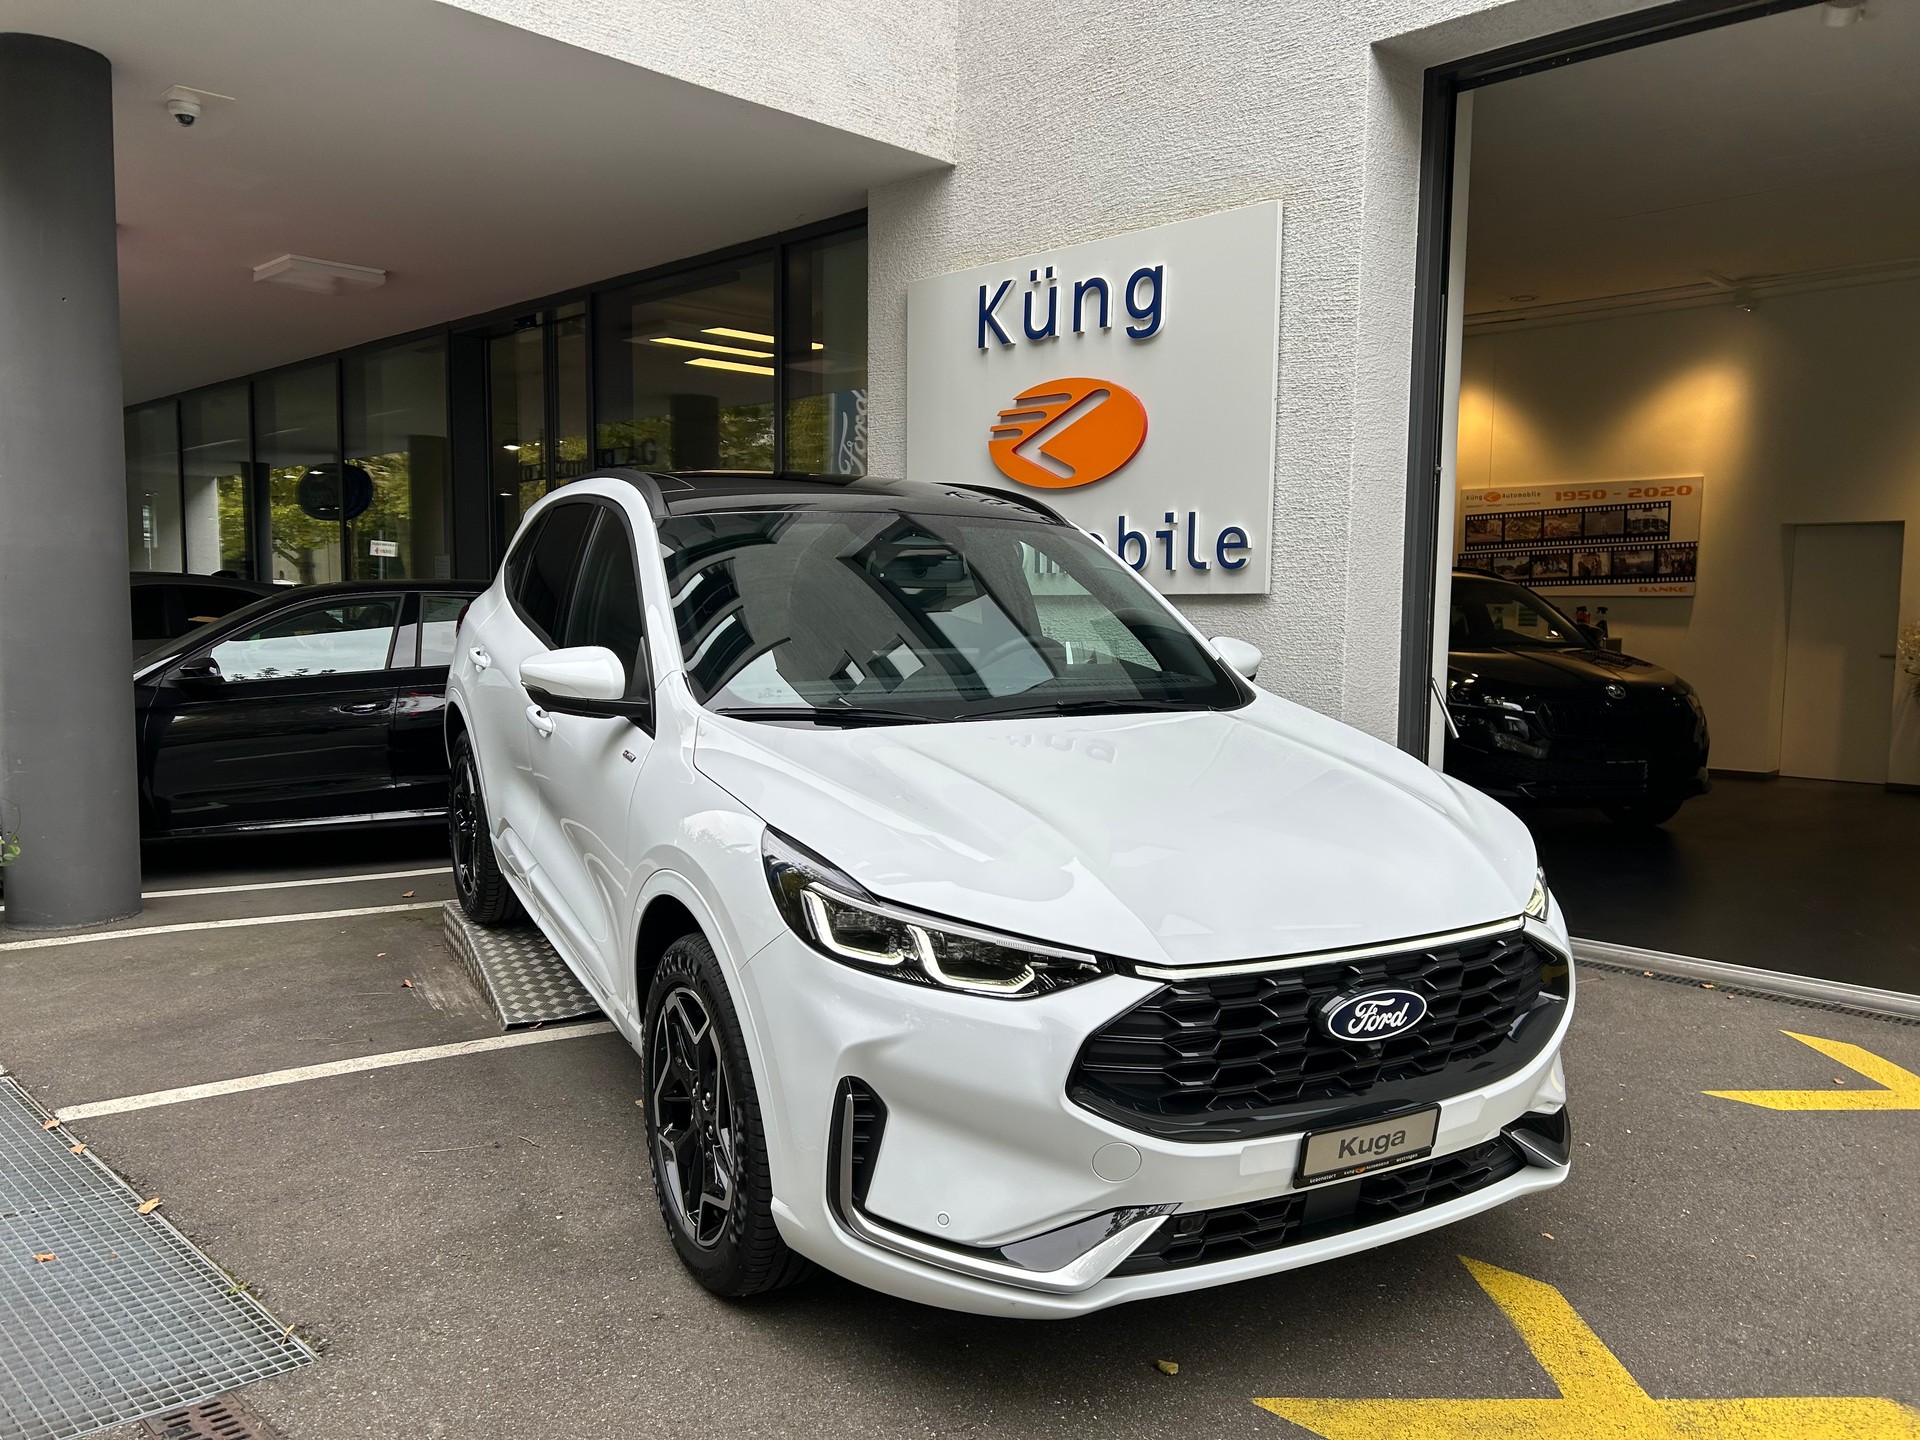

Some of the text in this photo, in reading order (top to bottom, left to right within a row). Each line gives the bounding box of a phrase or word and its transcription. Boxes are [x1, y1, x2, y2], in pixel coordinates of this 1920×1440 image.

[977, 264, 1167, 350] Küng
[838, 388, 868, 475] Ford
[1502, 491, 1541, 499] Automobile
[1555, 489, 1607, 502] 1950
[1627, 485, 1693, 499] 2020
[1089, 510, 1252, 572] bile
[1638, 585, 1688, 593] DANKE
[1347, 997, 1410, 1035] Ford
[1337, 1129, 1407, 1159] Kuga
